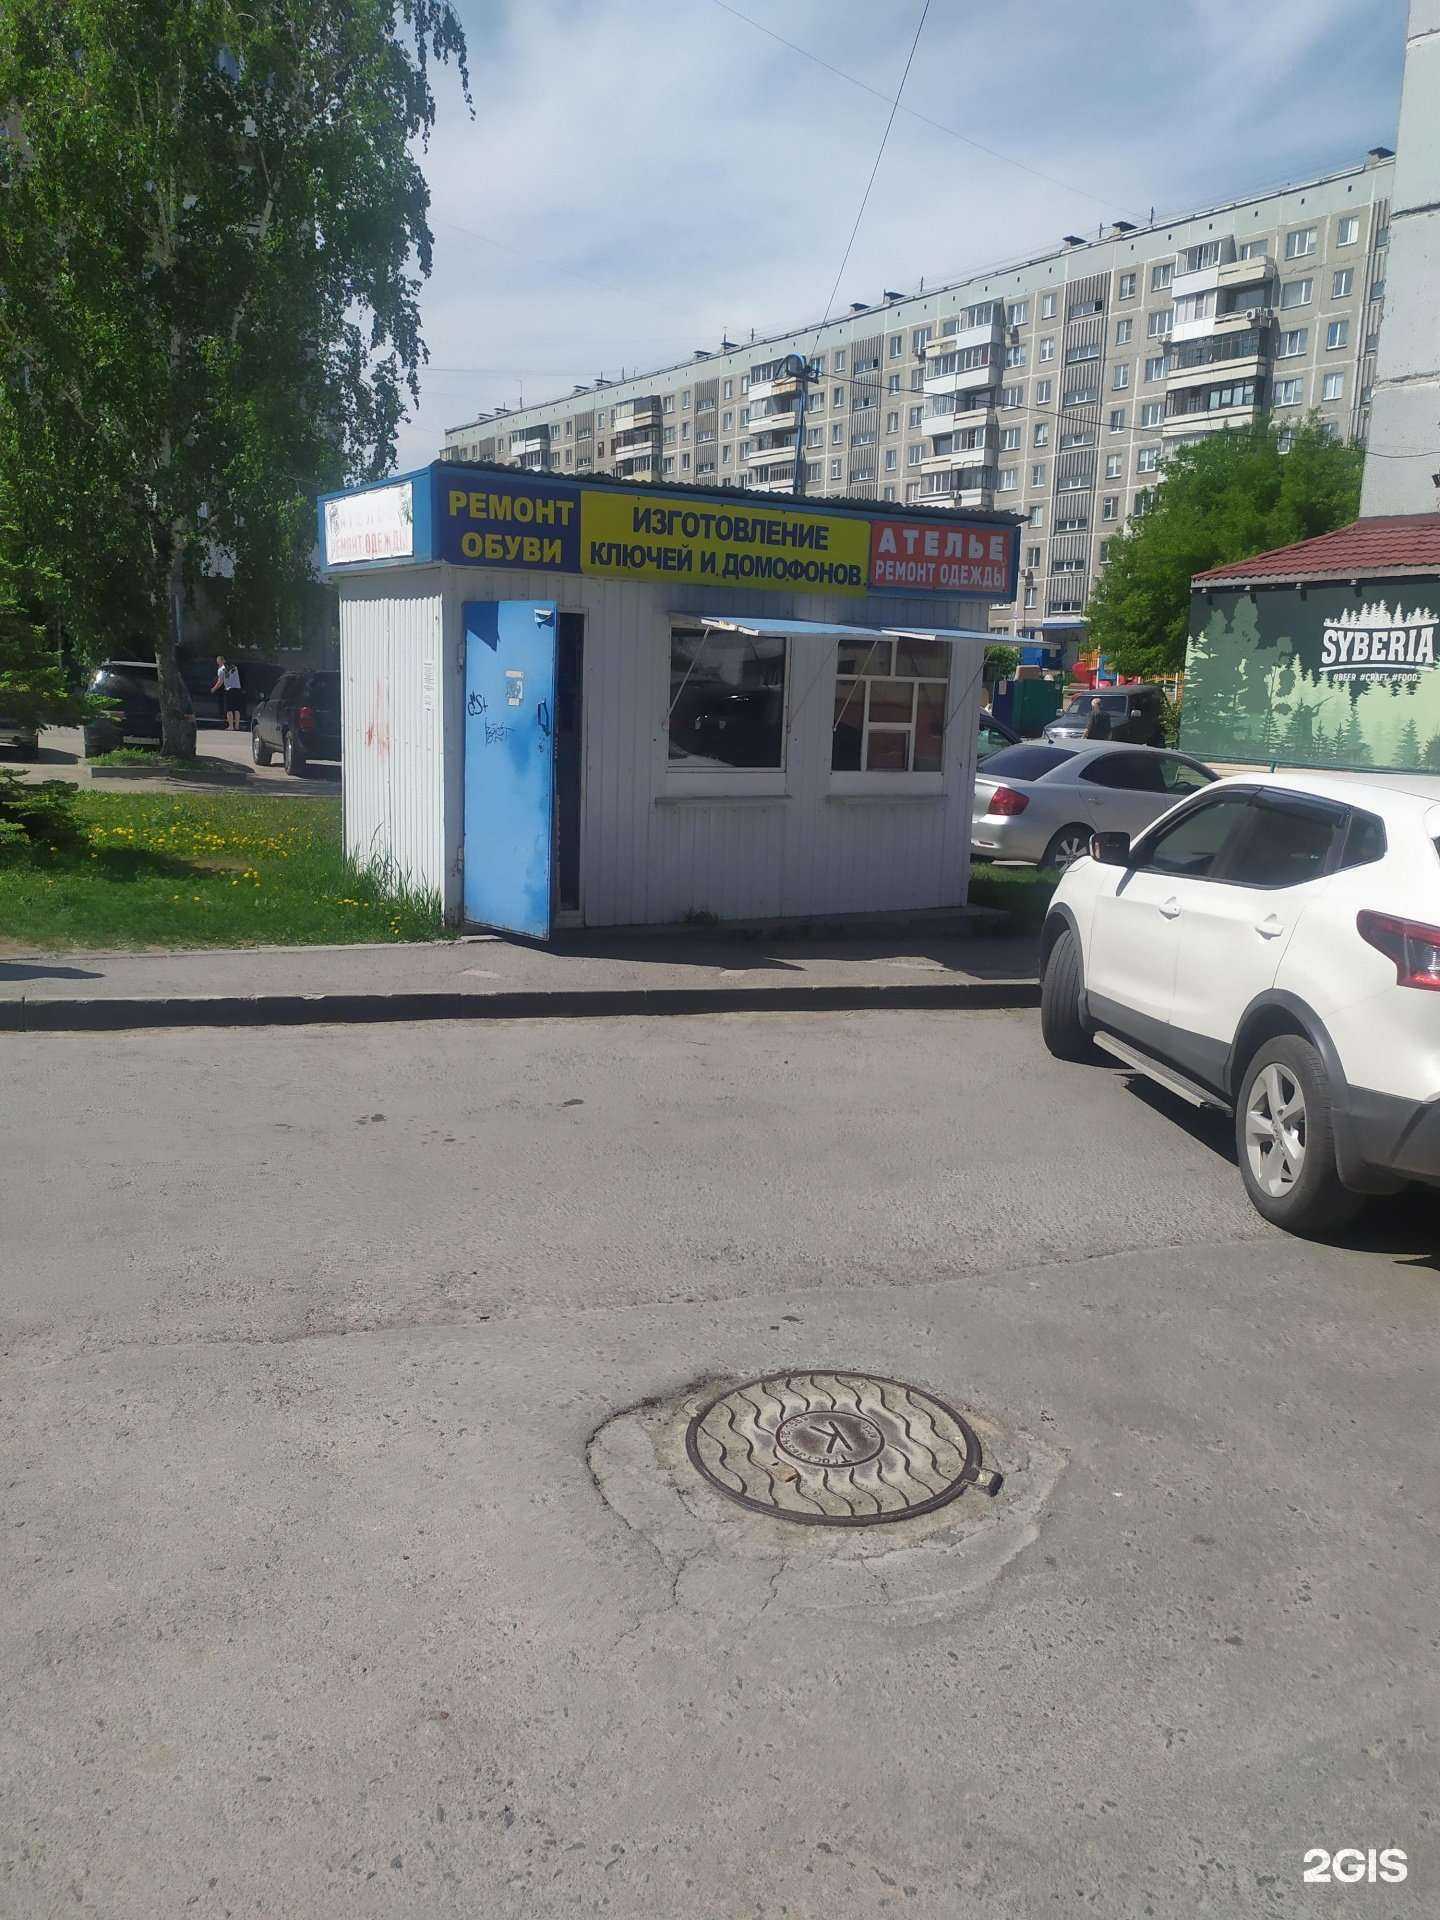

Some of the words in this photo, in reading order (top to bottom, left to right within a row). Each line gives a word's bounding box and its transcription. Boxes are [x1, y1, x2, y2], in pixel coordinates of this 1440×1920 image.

[448, 489, 575, 526] РЕМОНТ
[633, 506, 830, 550] ИЗГОТОВЛЕНИЕ
[878, 527, 1005, 560] АТЕЛЬЕ
[461, 532, 562, 563] ОБУВИ
[590, 541, 692, 572] КЛЮЧЕЙ
[701, 551, 716, 574] И
[722, 553, 862, 586] ДОМОФОНОВ
[875, 559, 936, 582] РЕМОНТ
[940, 563, 1006, 588] ОДЕЖДЫ
[1321, 627, 1434, 664] SYBERIA
[1392, 673, 1418, 681] #FOOD
